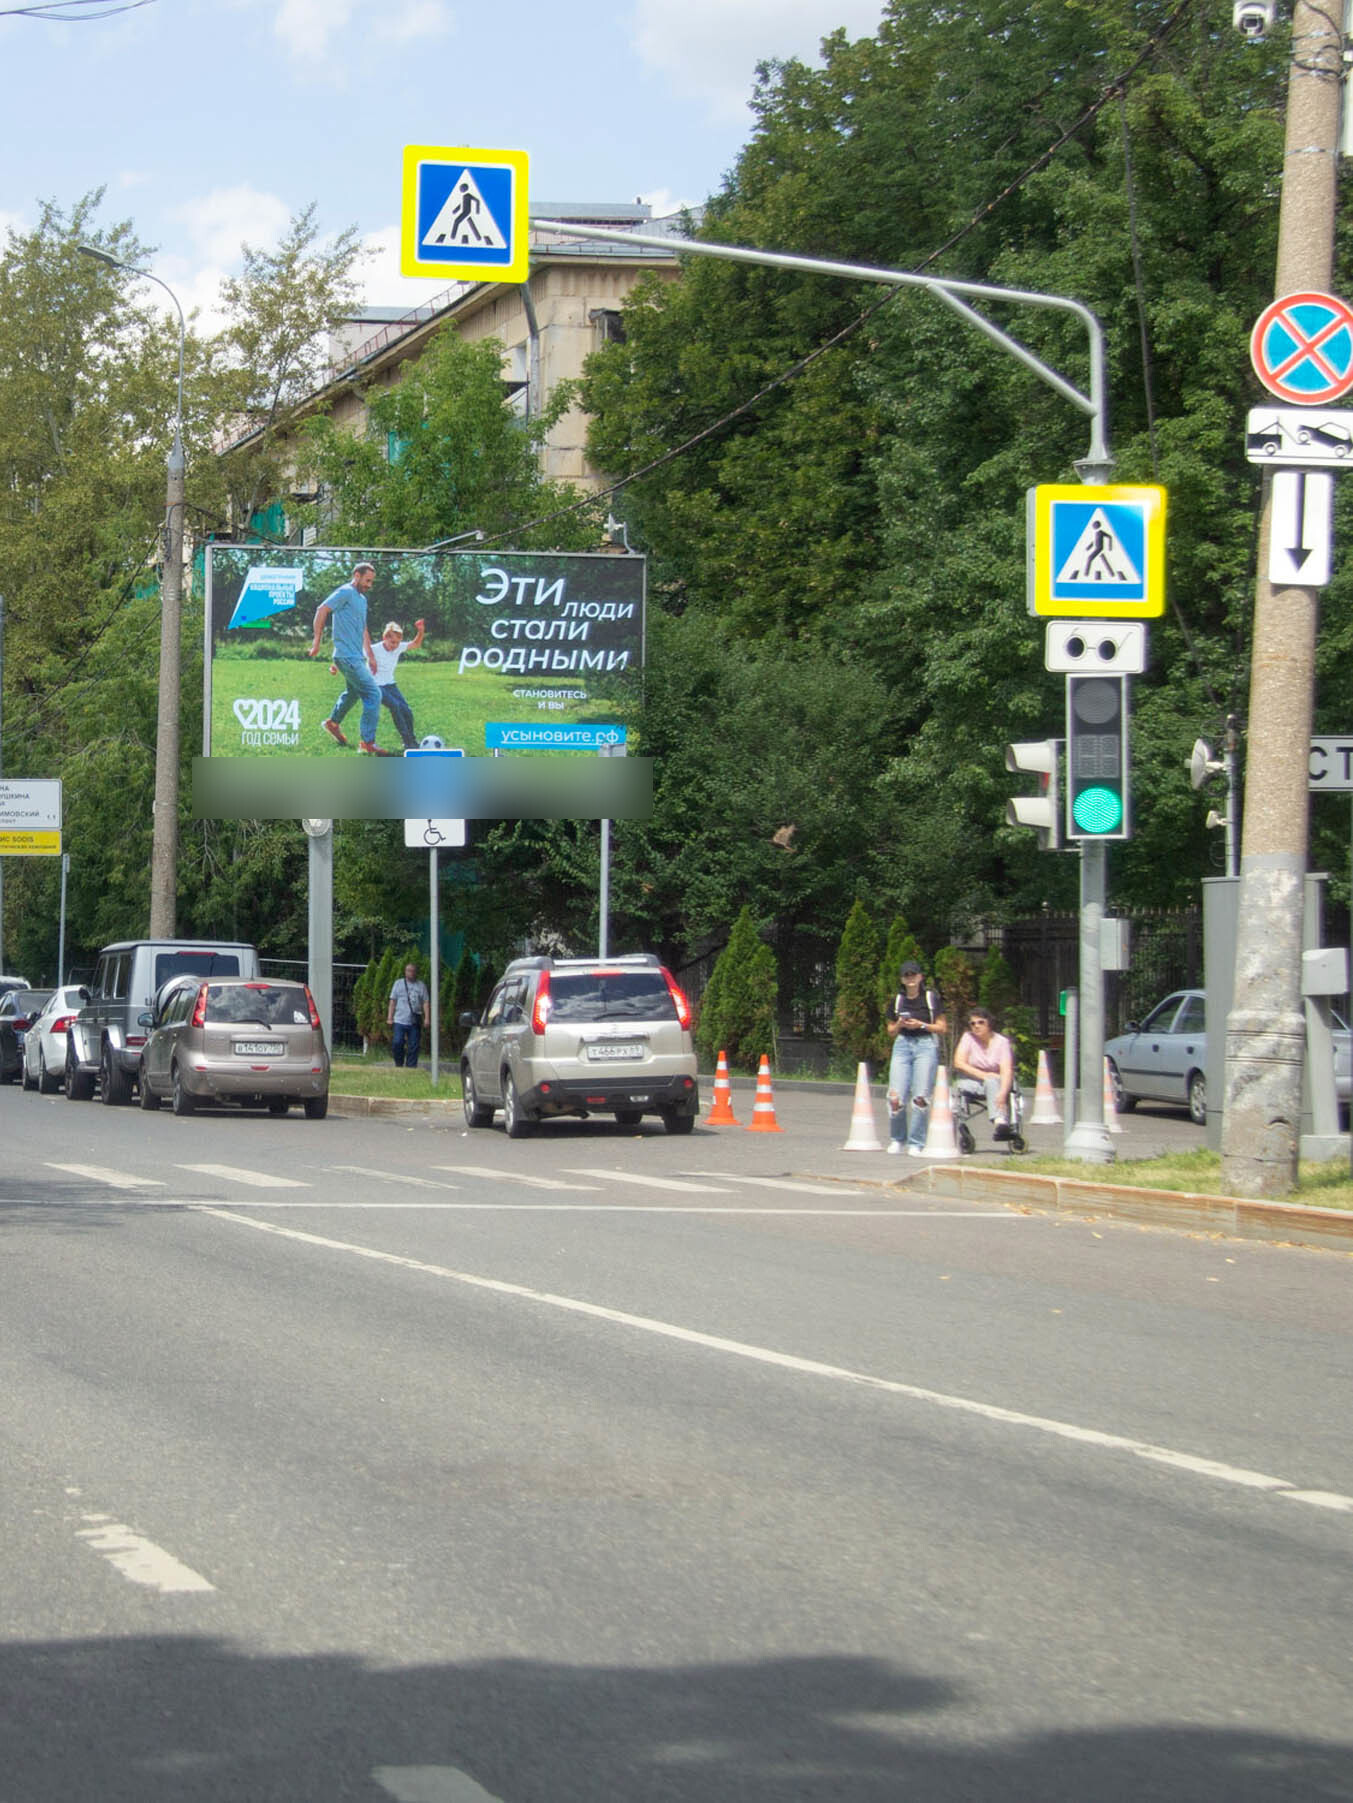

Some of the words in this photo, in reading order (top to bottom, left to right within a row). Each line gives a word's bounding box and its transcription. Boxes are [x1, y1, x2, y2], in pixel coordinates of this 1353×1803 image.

[475, 567, 566, 606] Эти
[561, 601, 635, 621] люди
[491, 619, 590, 641] стали
[457, 646, 629, 675] родными
[512, 689, 588, 699] СТАНОВИТЕСЬ
[233, 698, 301, 730] 2024
[537, 701, 547, 710] И
[548, 701, 565, 710] ВЫ
[241, 731, 262, 746] ГОД
[501, 729, 619, 744] усыновите.рф
